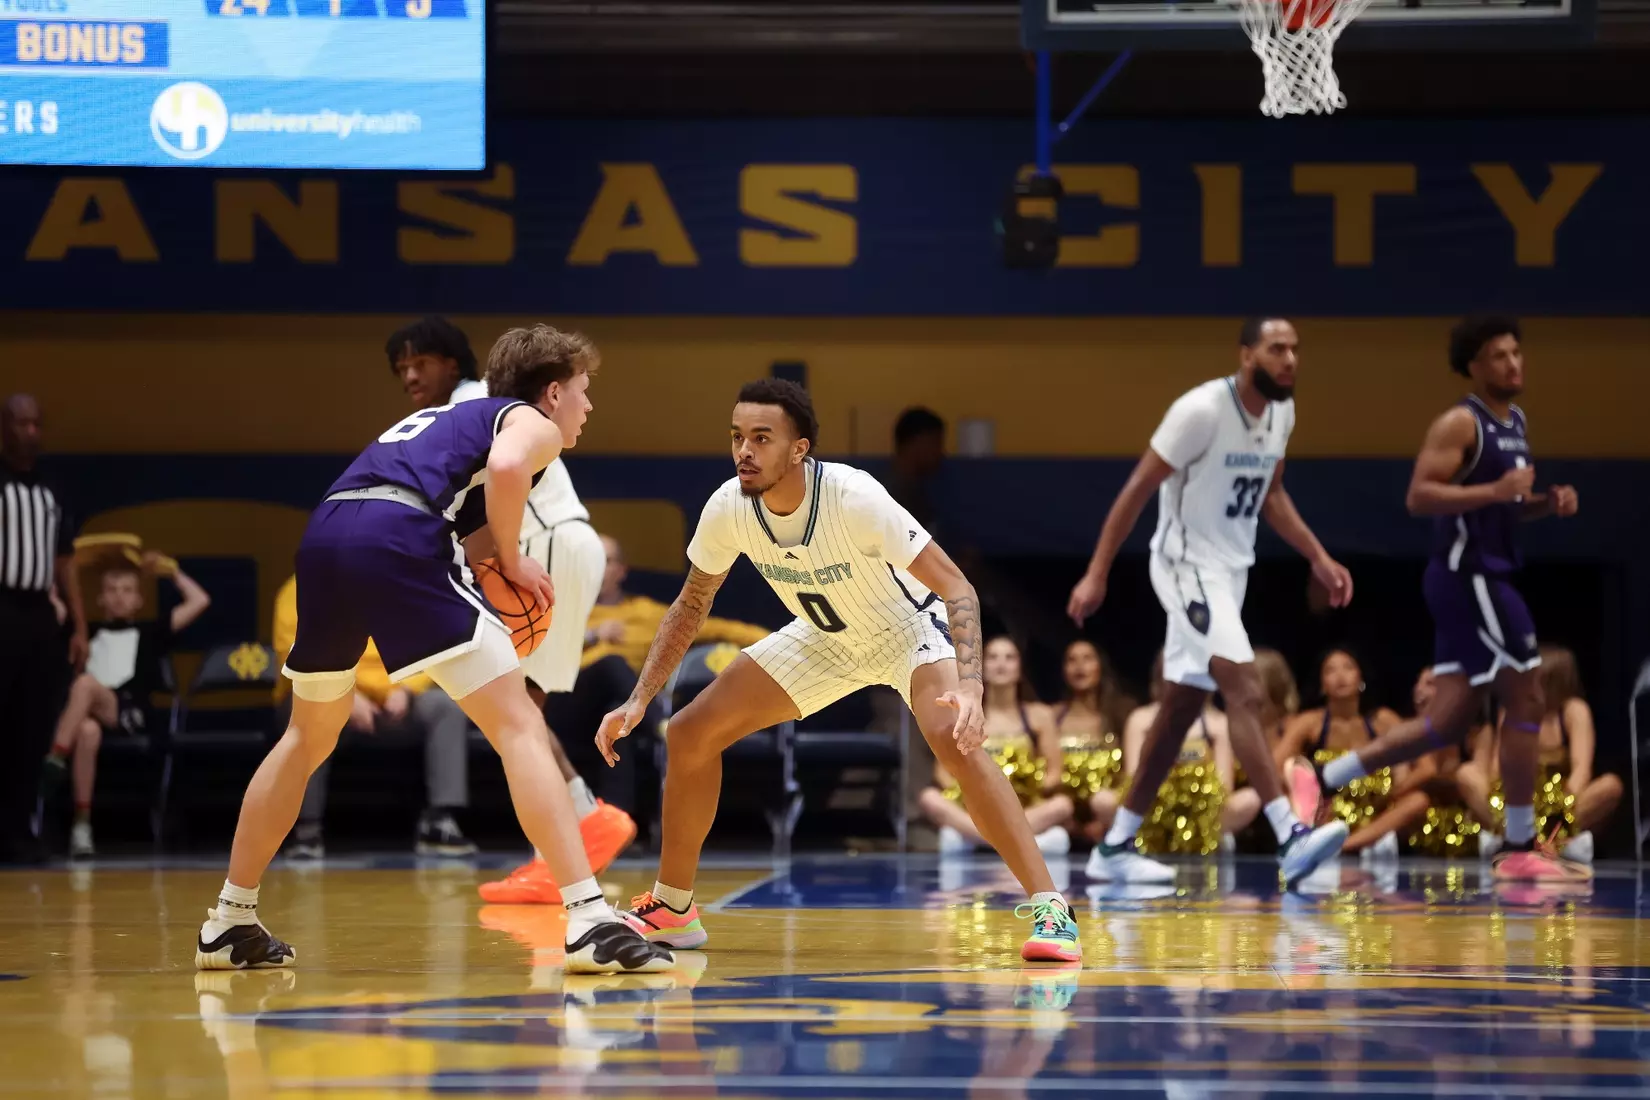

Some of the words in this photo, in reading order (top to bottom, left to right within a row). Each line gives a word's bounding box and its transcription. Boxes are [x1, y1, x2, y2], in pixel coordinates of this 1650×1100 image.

[15, 23, 146, 63] BONUS
[1014, 163, 1605, 267] CITY
[378, 403, 456, 443] 6
[1226, 475, 1266, 518] 33
[814, 562, 853, 585] CITY
[796, 592, 848, 633] 0
